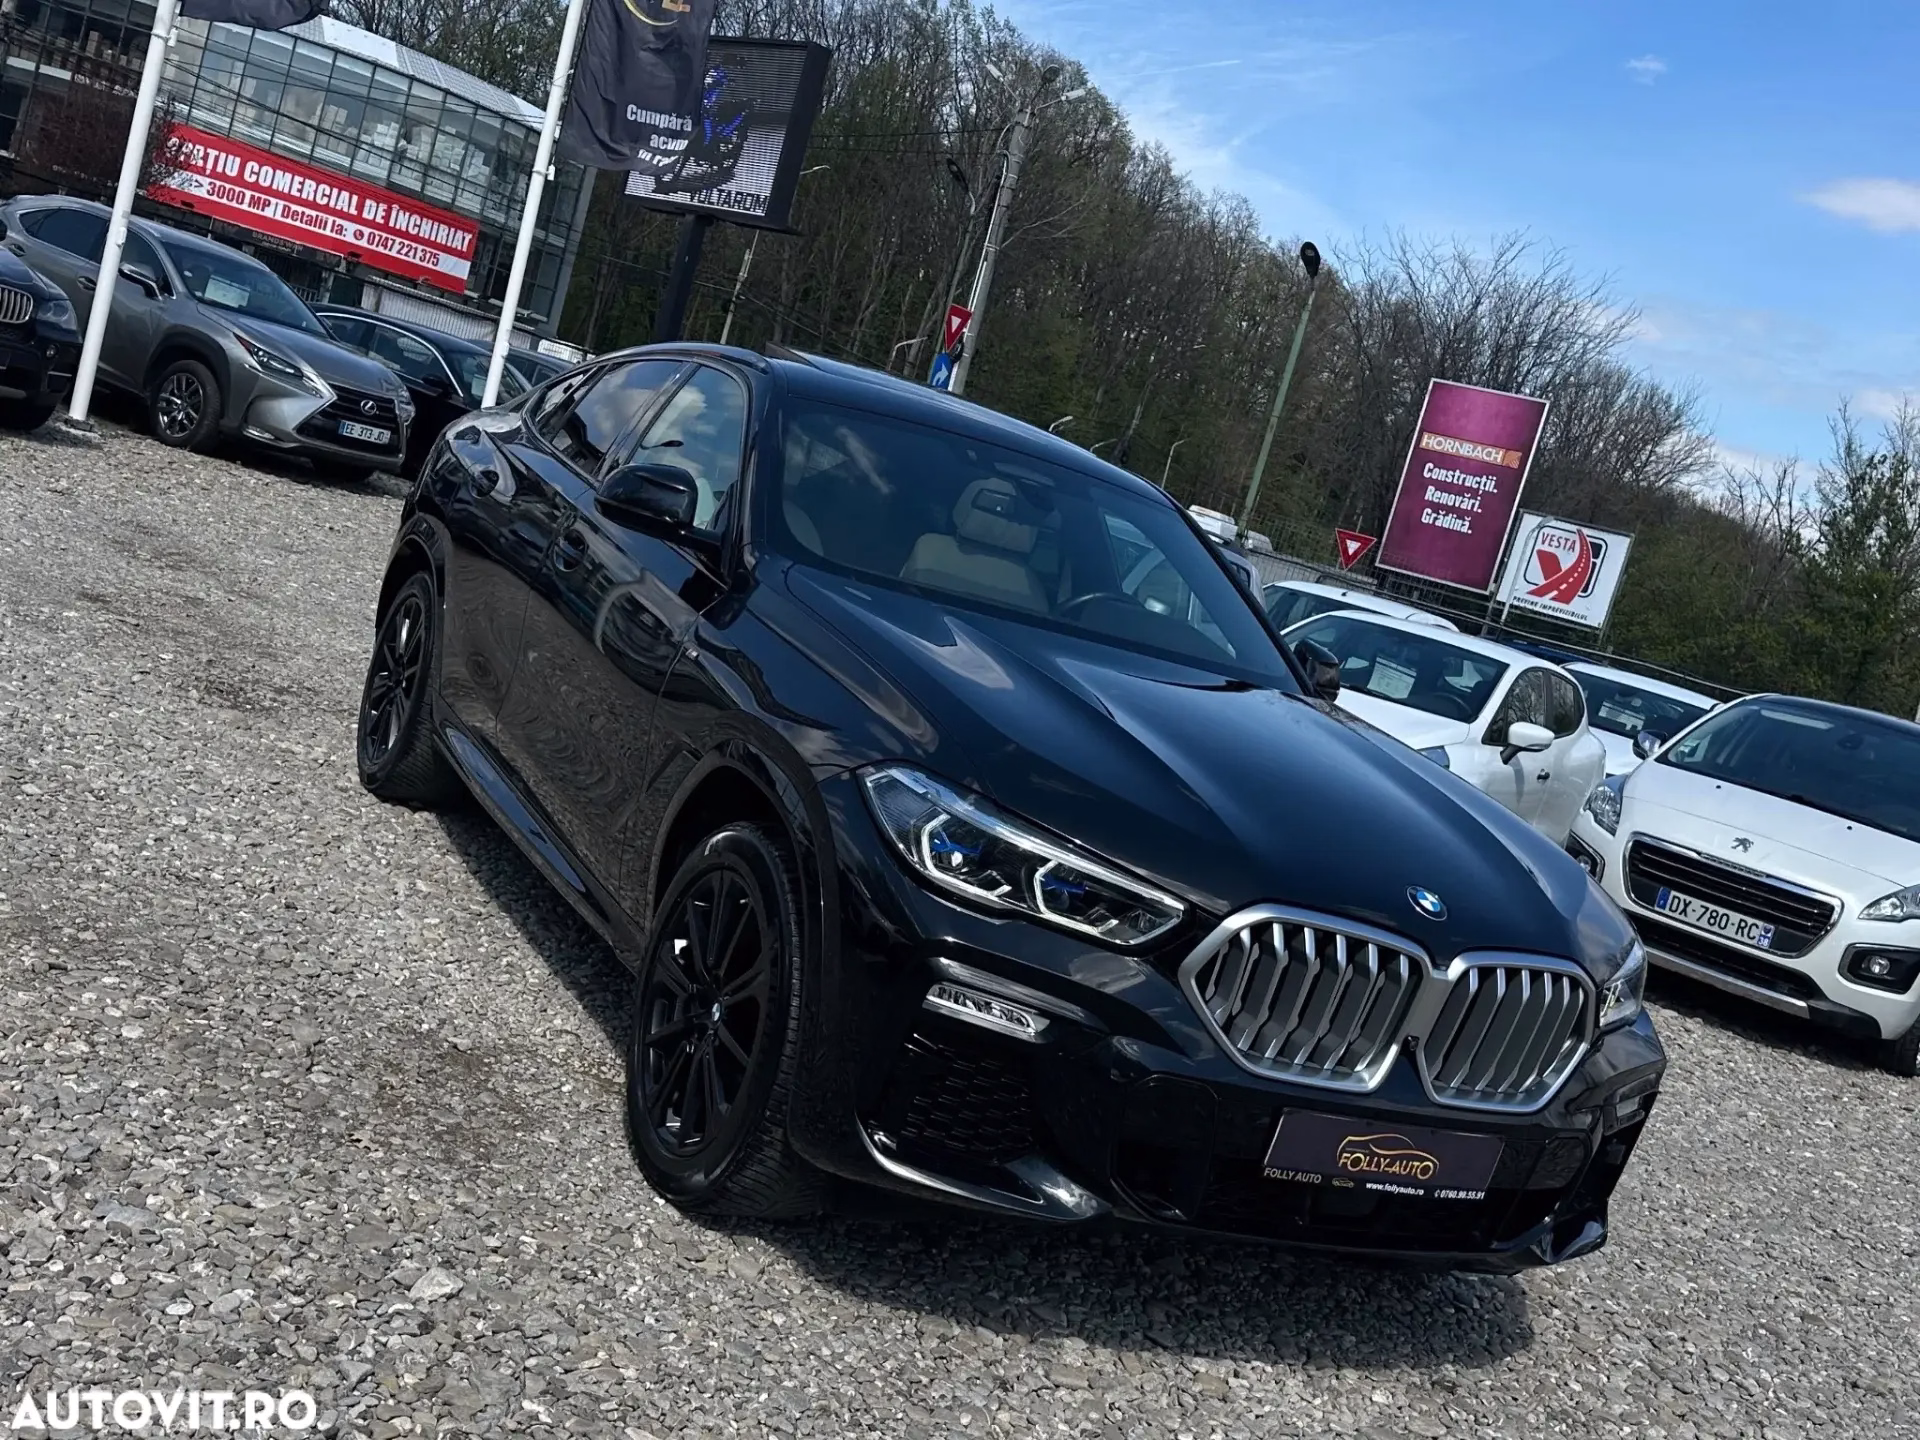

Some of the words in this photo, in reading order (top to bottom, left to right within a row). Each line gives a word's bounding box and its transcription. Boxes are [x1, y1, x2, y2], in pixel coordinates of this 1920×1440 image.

[626, 104, 692, 131] Cumpără
[649, 134, 689, 151] acum
[243, 160, 359, 216] COMERCIAL
[362, 199, 388, 223] DE
[387, 204, 474, 253] ÎNCHIRIAT
[206, 180, 246, 207] 3000
[247, 194, 272, 214] MP
[281, 204, 332, 231] Detalii
[331, 219, 348, 238] la:
[366, 231, 397, 254] 0747
[398, 240, 420, 262] 221
[420, 249, 440, 268] 375
[1421, 434, 1504, 463] HORNBACH
[1423, 461, 1498, 494] Construcții.
[1424, 485, 1482, 513] Renovări.
[1421, 507, 1472, 534] Grădină.
[1541, 531, 1577, 554] VESTA
[1668, 895, 1759, 940] DX-780-RC
[1759, 936, 1769, 947] 38
[1264, 1167, 1296, 1181] FOLLY
[1294, 1171, 1322, 1184] AUTO
